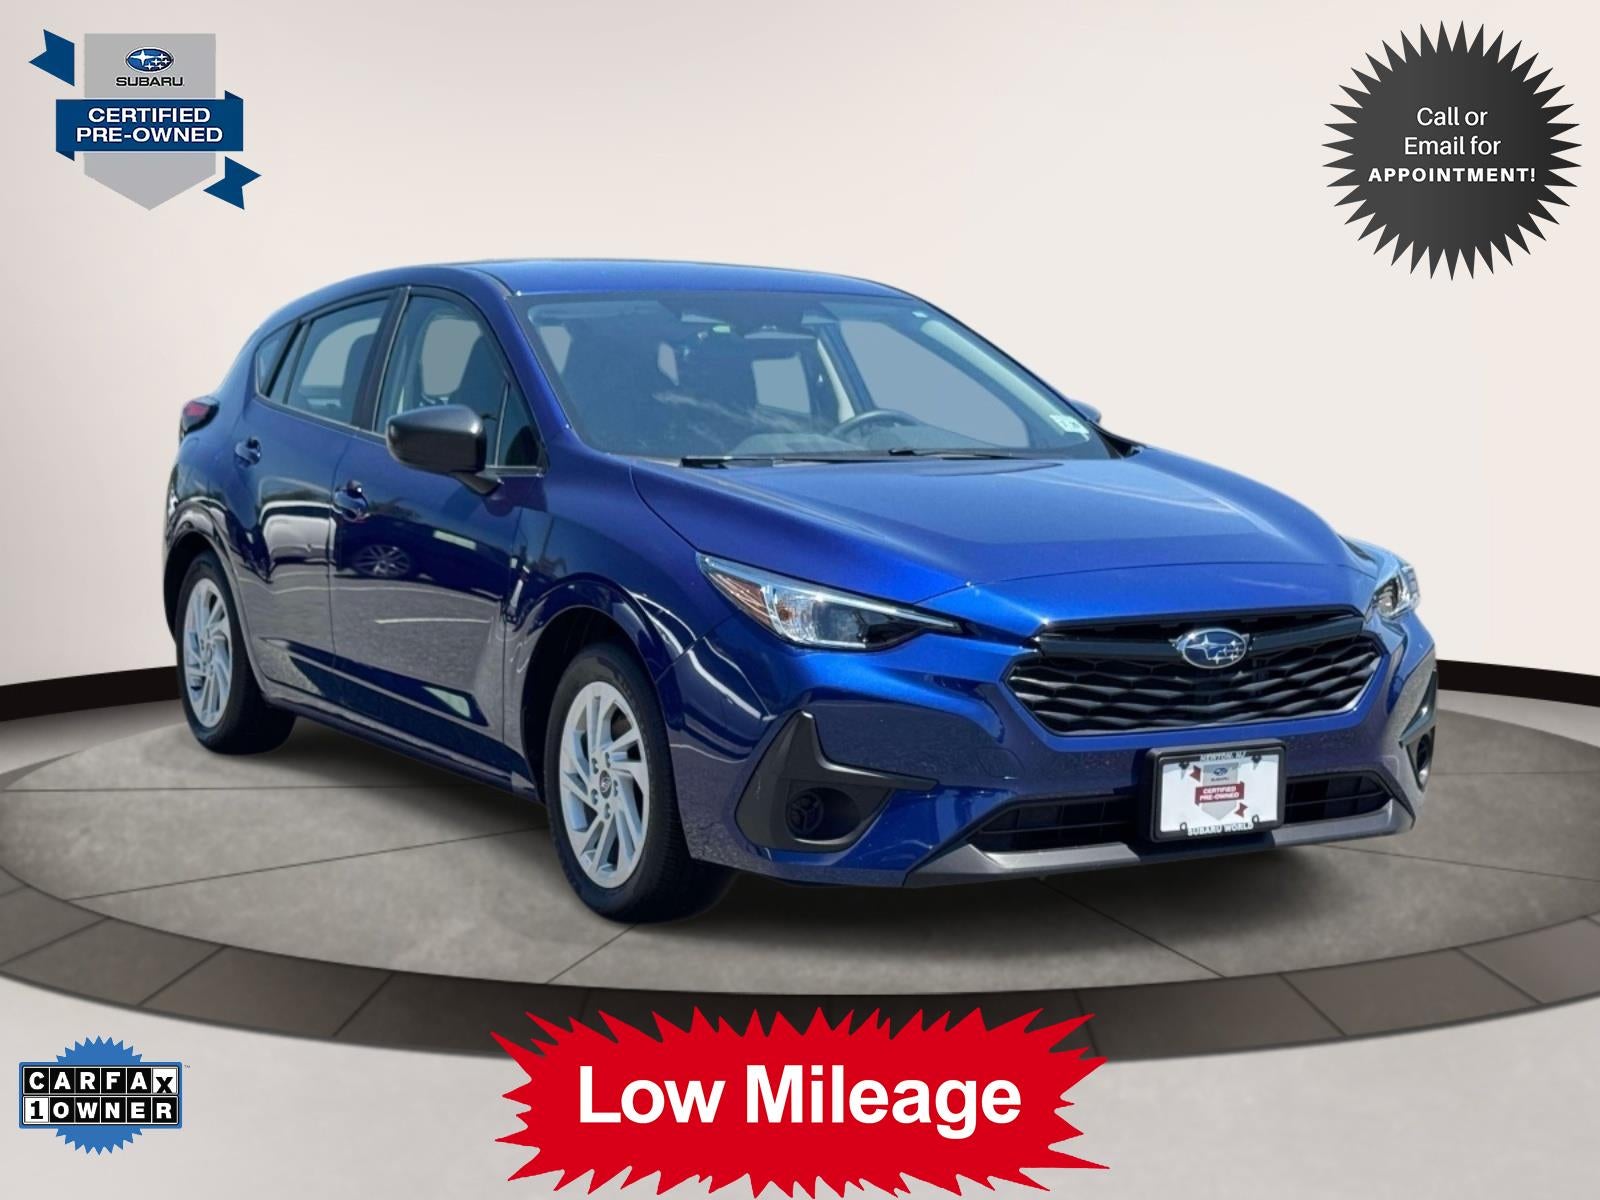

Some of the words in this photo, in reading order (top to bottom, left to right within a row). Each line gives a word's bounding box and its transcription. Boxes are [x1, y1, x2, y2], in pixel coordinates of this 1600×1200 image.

[1203, 786, 1237, 795] CERTIFIED
[1199, 792, 1240, 801] PRE-OWNED
[1187, 824, 1222, 837] SUBARU
[1223, 822, 1254, 833] WORLD
